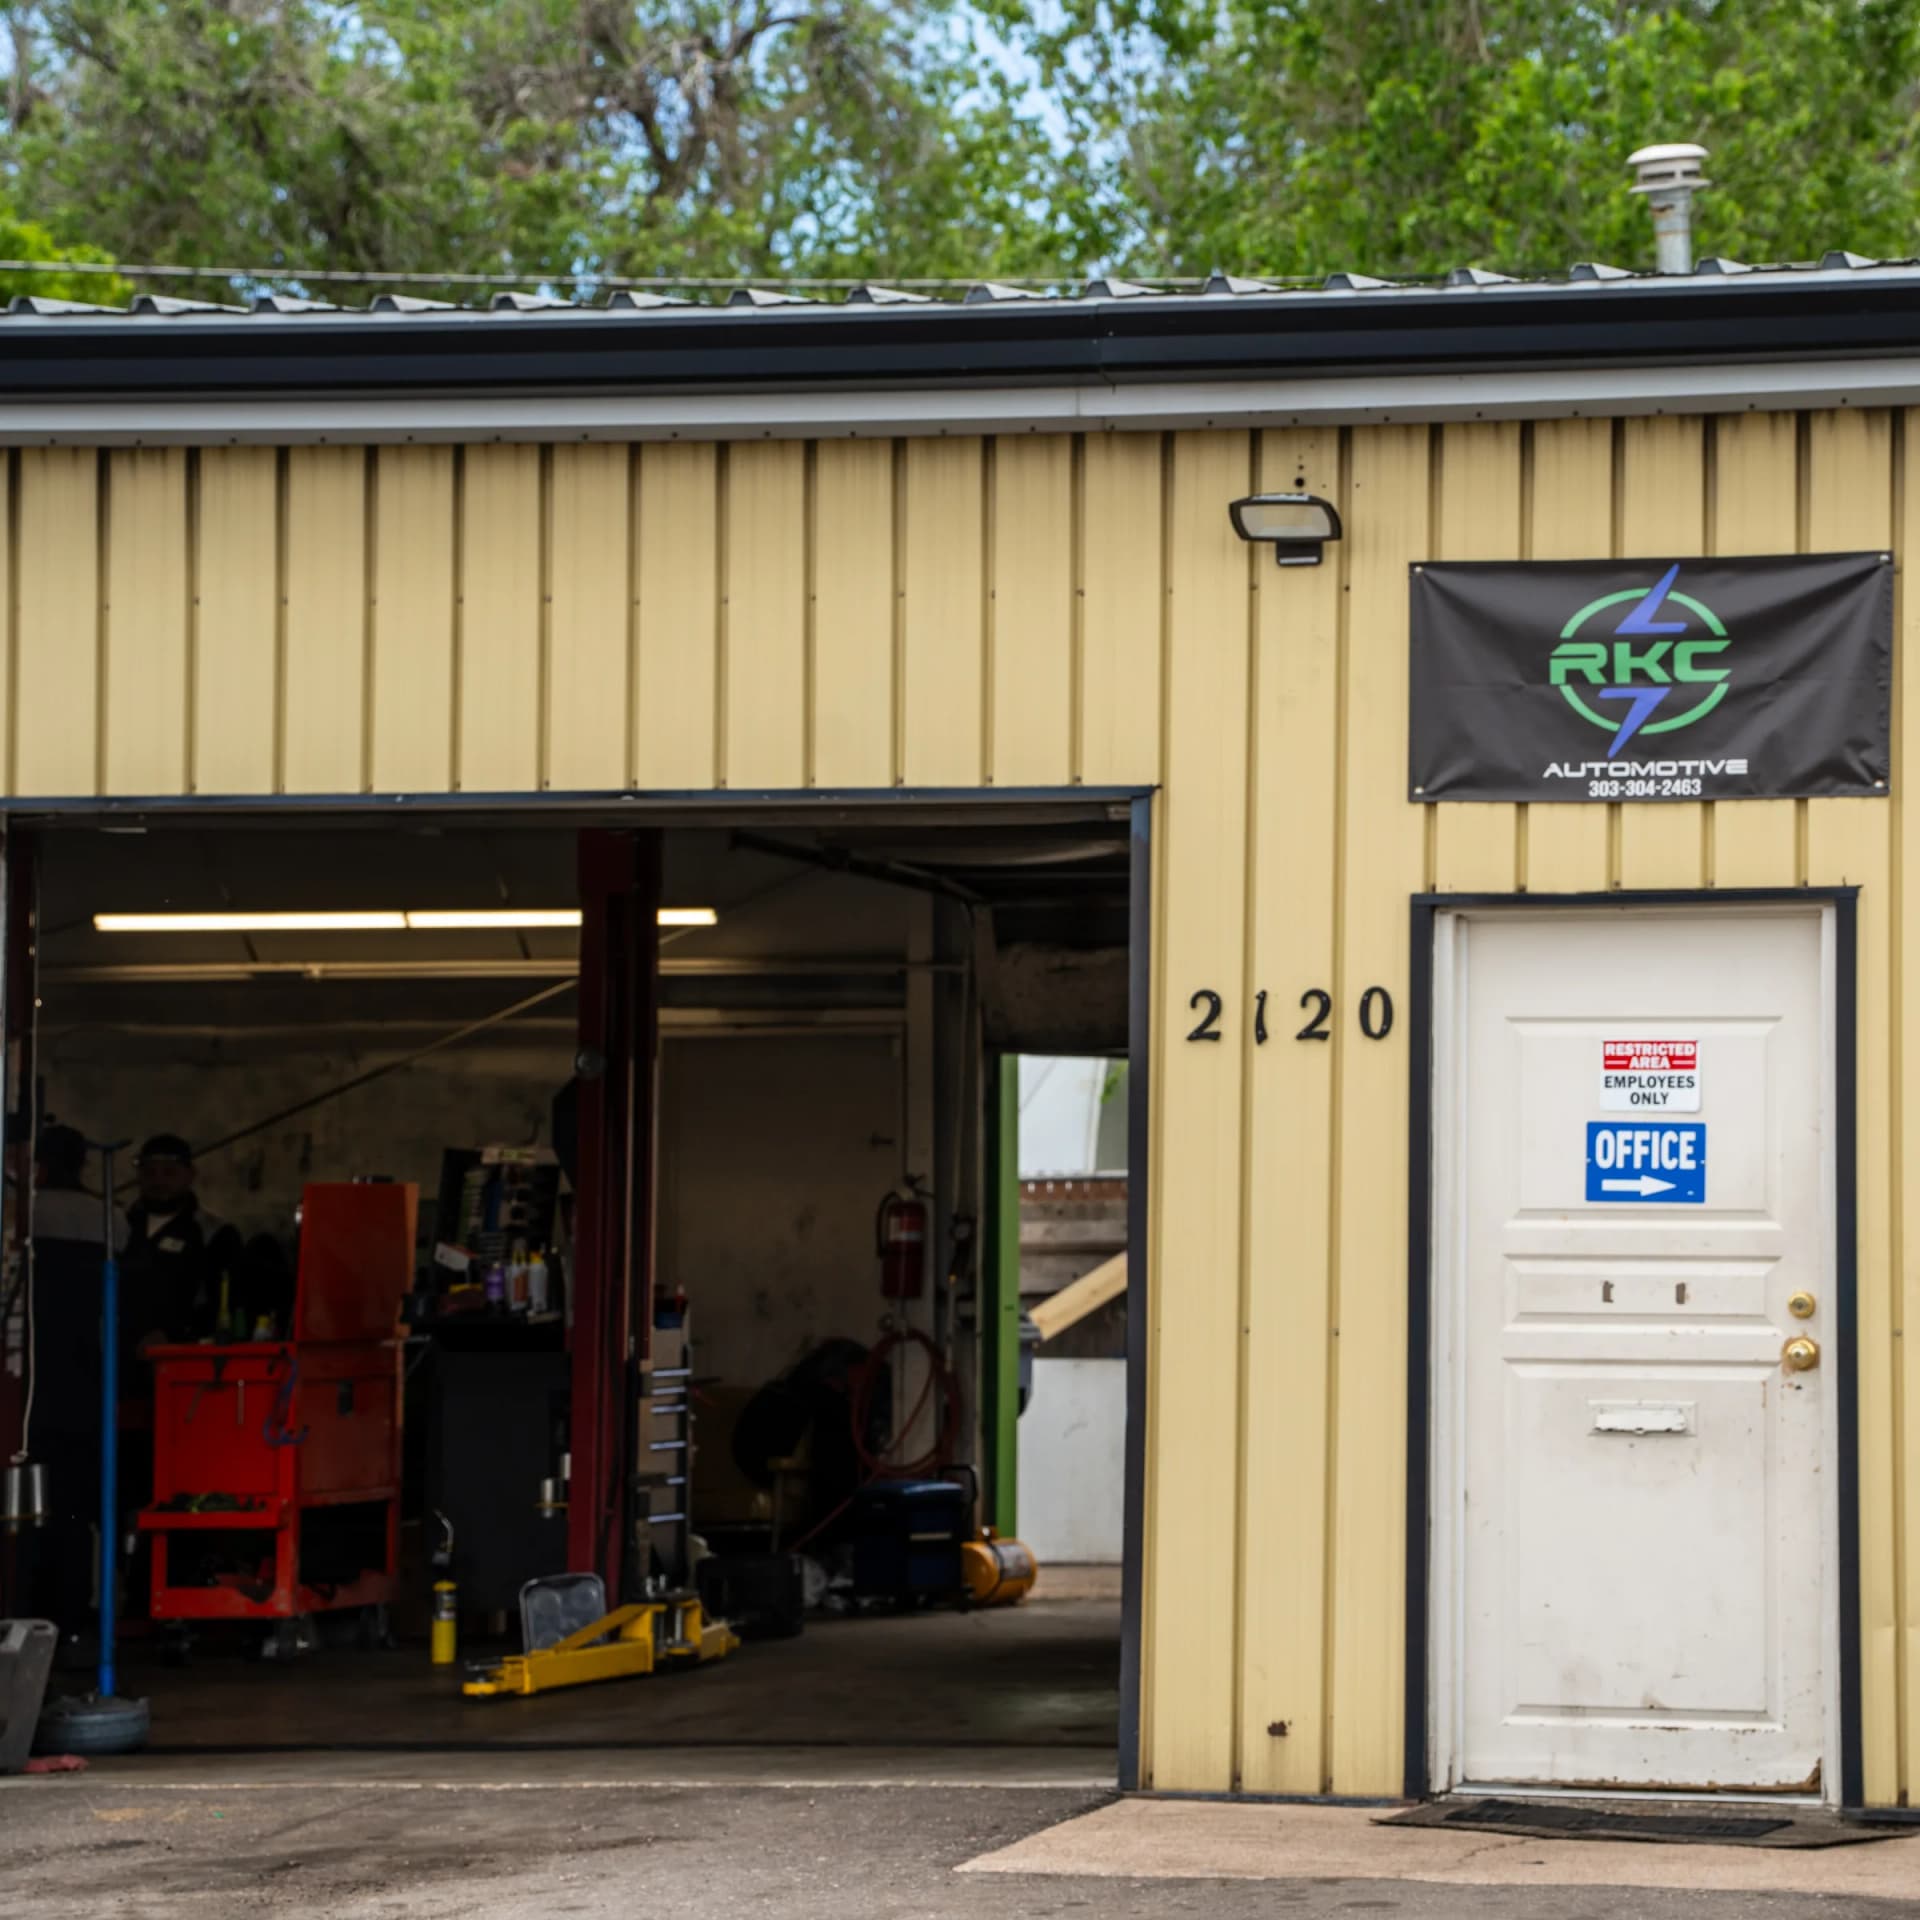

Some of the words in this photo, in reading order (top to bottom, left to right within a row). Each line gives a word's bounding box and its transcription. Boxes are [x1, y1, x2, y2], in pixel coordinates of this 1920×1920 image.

[1550, 641, 1732, 685] RKC
[1543, 758, 1748, 778] AUTOMOTIVE
[1588, 779, 1702, 797] 303-304-2463
[1186, 986, 1394, 1045] 2120
[1604, 1043, 1695, 1056] RESTRICTED
[1629, 1056, 1671, 1069] AREA
[1604, 1076, 1695, 1088] EMPLOYEES
[1630, 1092, 1669, 1105] ONLY
[1595, 1129, 1697, 1170] OFFICE
